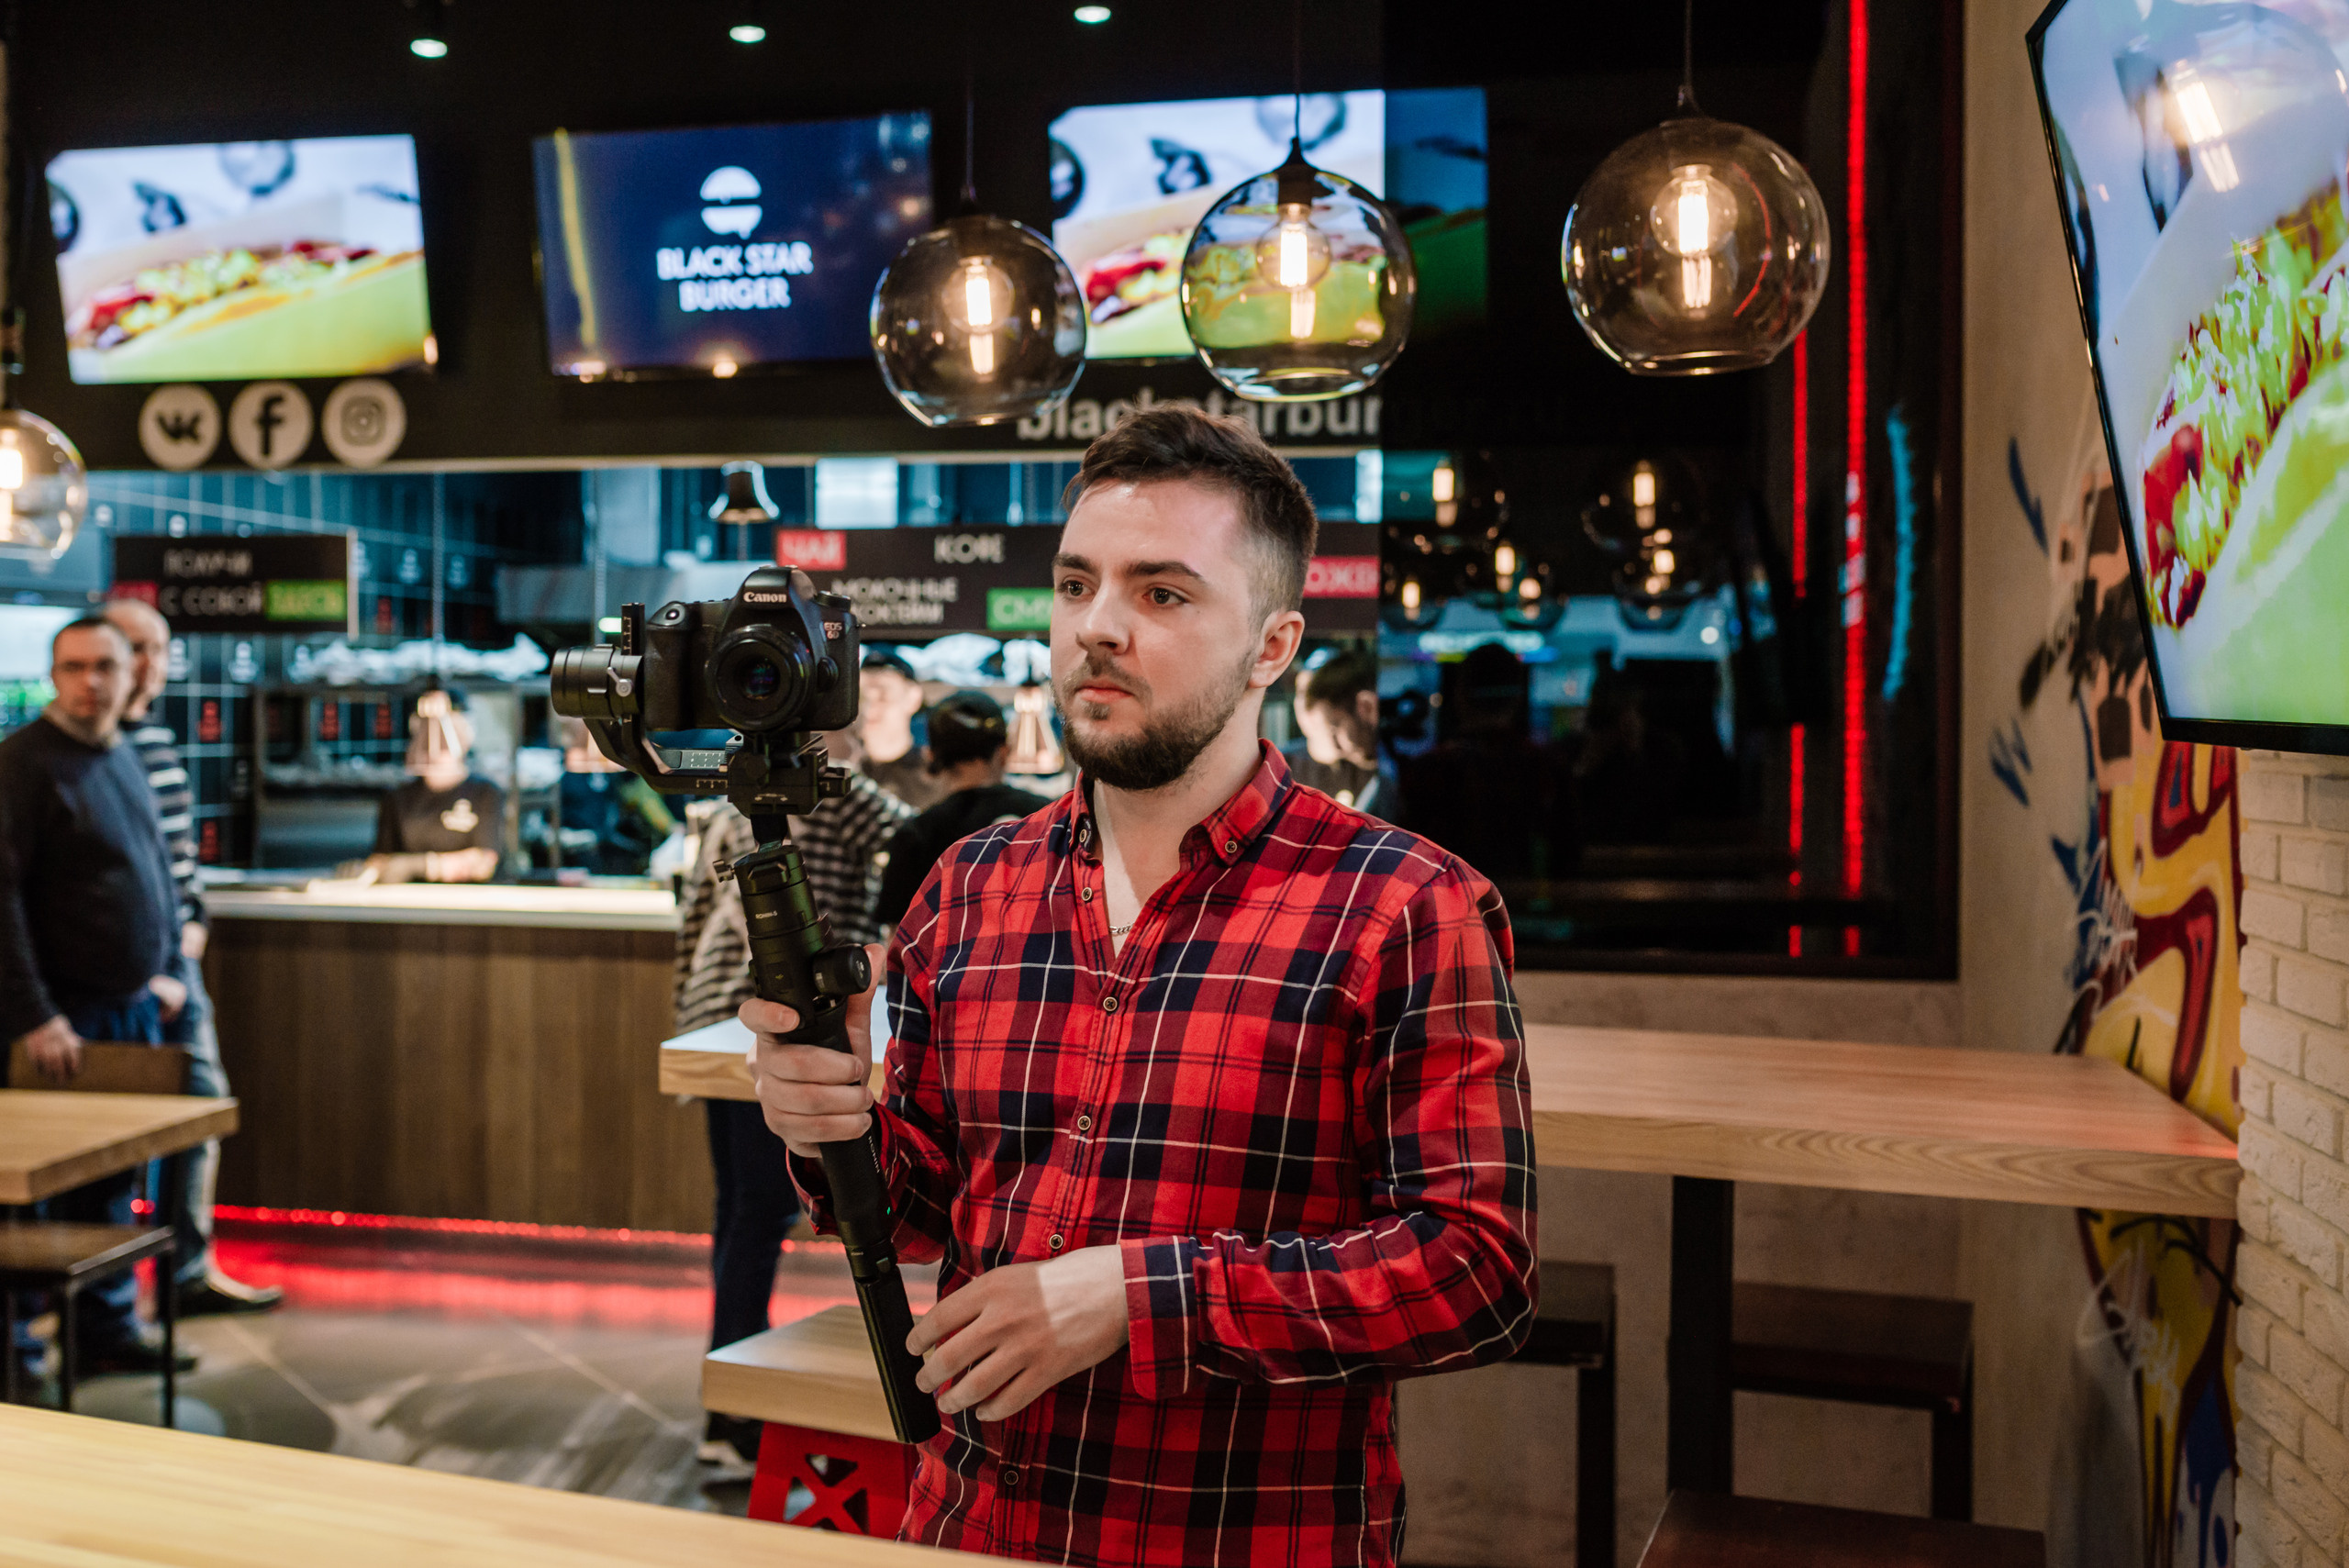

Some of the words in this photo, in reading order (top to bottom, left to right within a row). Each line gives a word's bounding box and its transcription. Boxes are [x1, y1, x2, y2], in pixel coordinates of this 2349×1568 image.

[657, 245, 744, 280] BLACK
[744, 241, 813, 275] STAR
[679, 276, 791, 312] BURGER
[743, 592, 786, 604] Canon
[824, 622, 842, 631] EOS
[827, 630, 840, 639] 6D
